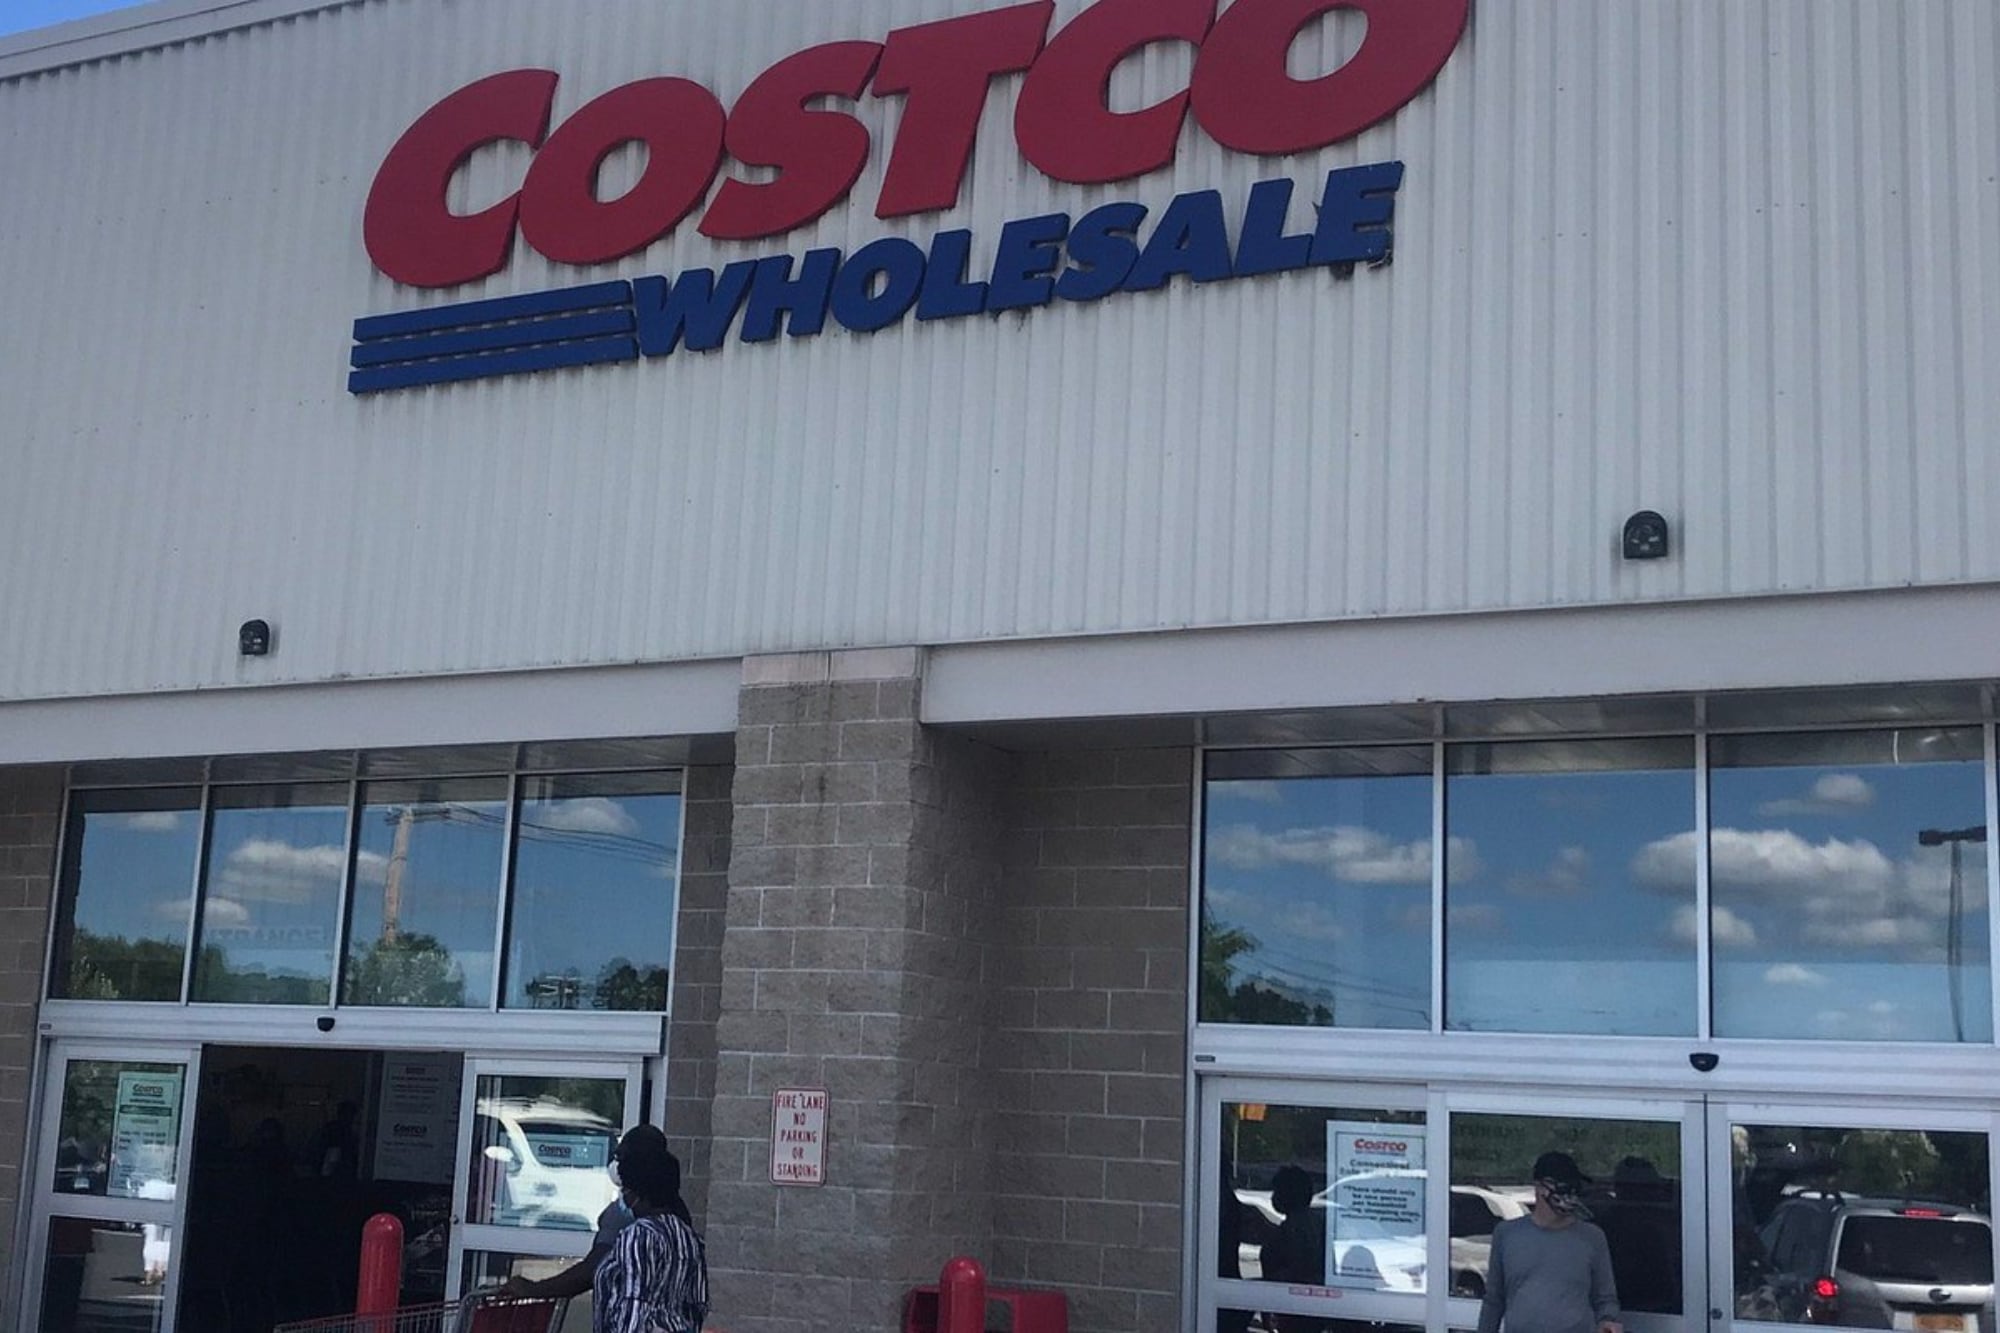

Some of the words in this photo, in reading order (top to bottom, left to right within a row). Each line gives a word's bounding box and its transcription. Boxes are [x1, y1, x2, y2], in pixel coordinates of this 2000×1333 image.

[363, 0, 1475, 288] COSTCO
[632, 160, 1404, 357] WHOLESALE
[778, 1095, 796, 1109] FIRE
[801, 1095, 824, 1110] LANE
[793, 1112, 806, 1126] NO
[780, 1129, 817, 1144] PARKING
[792, 1147, 804, 1159] OR
[777, 1163, 817, 1177] STANDING
